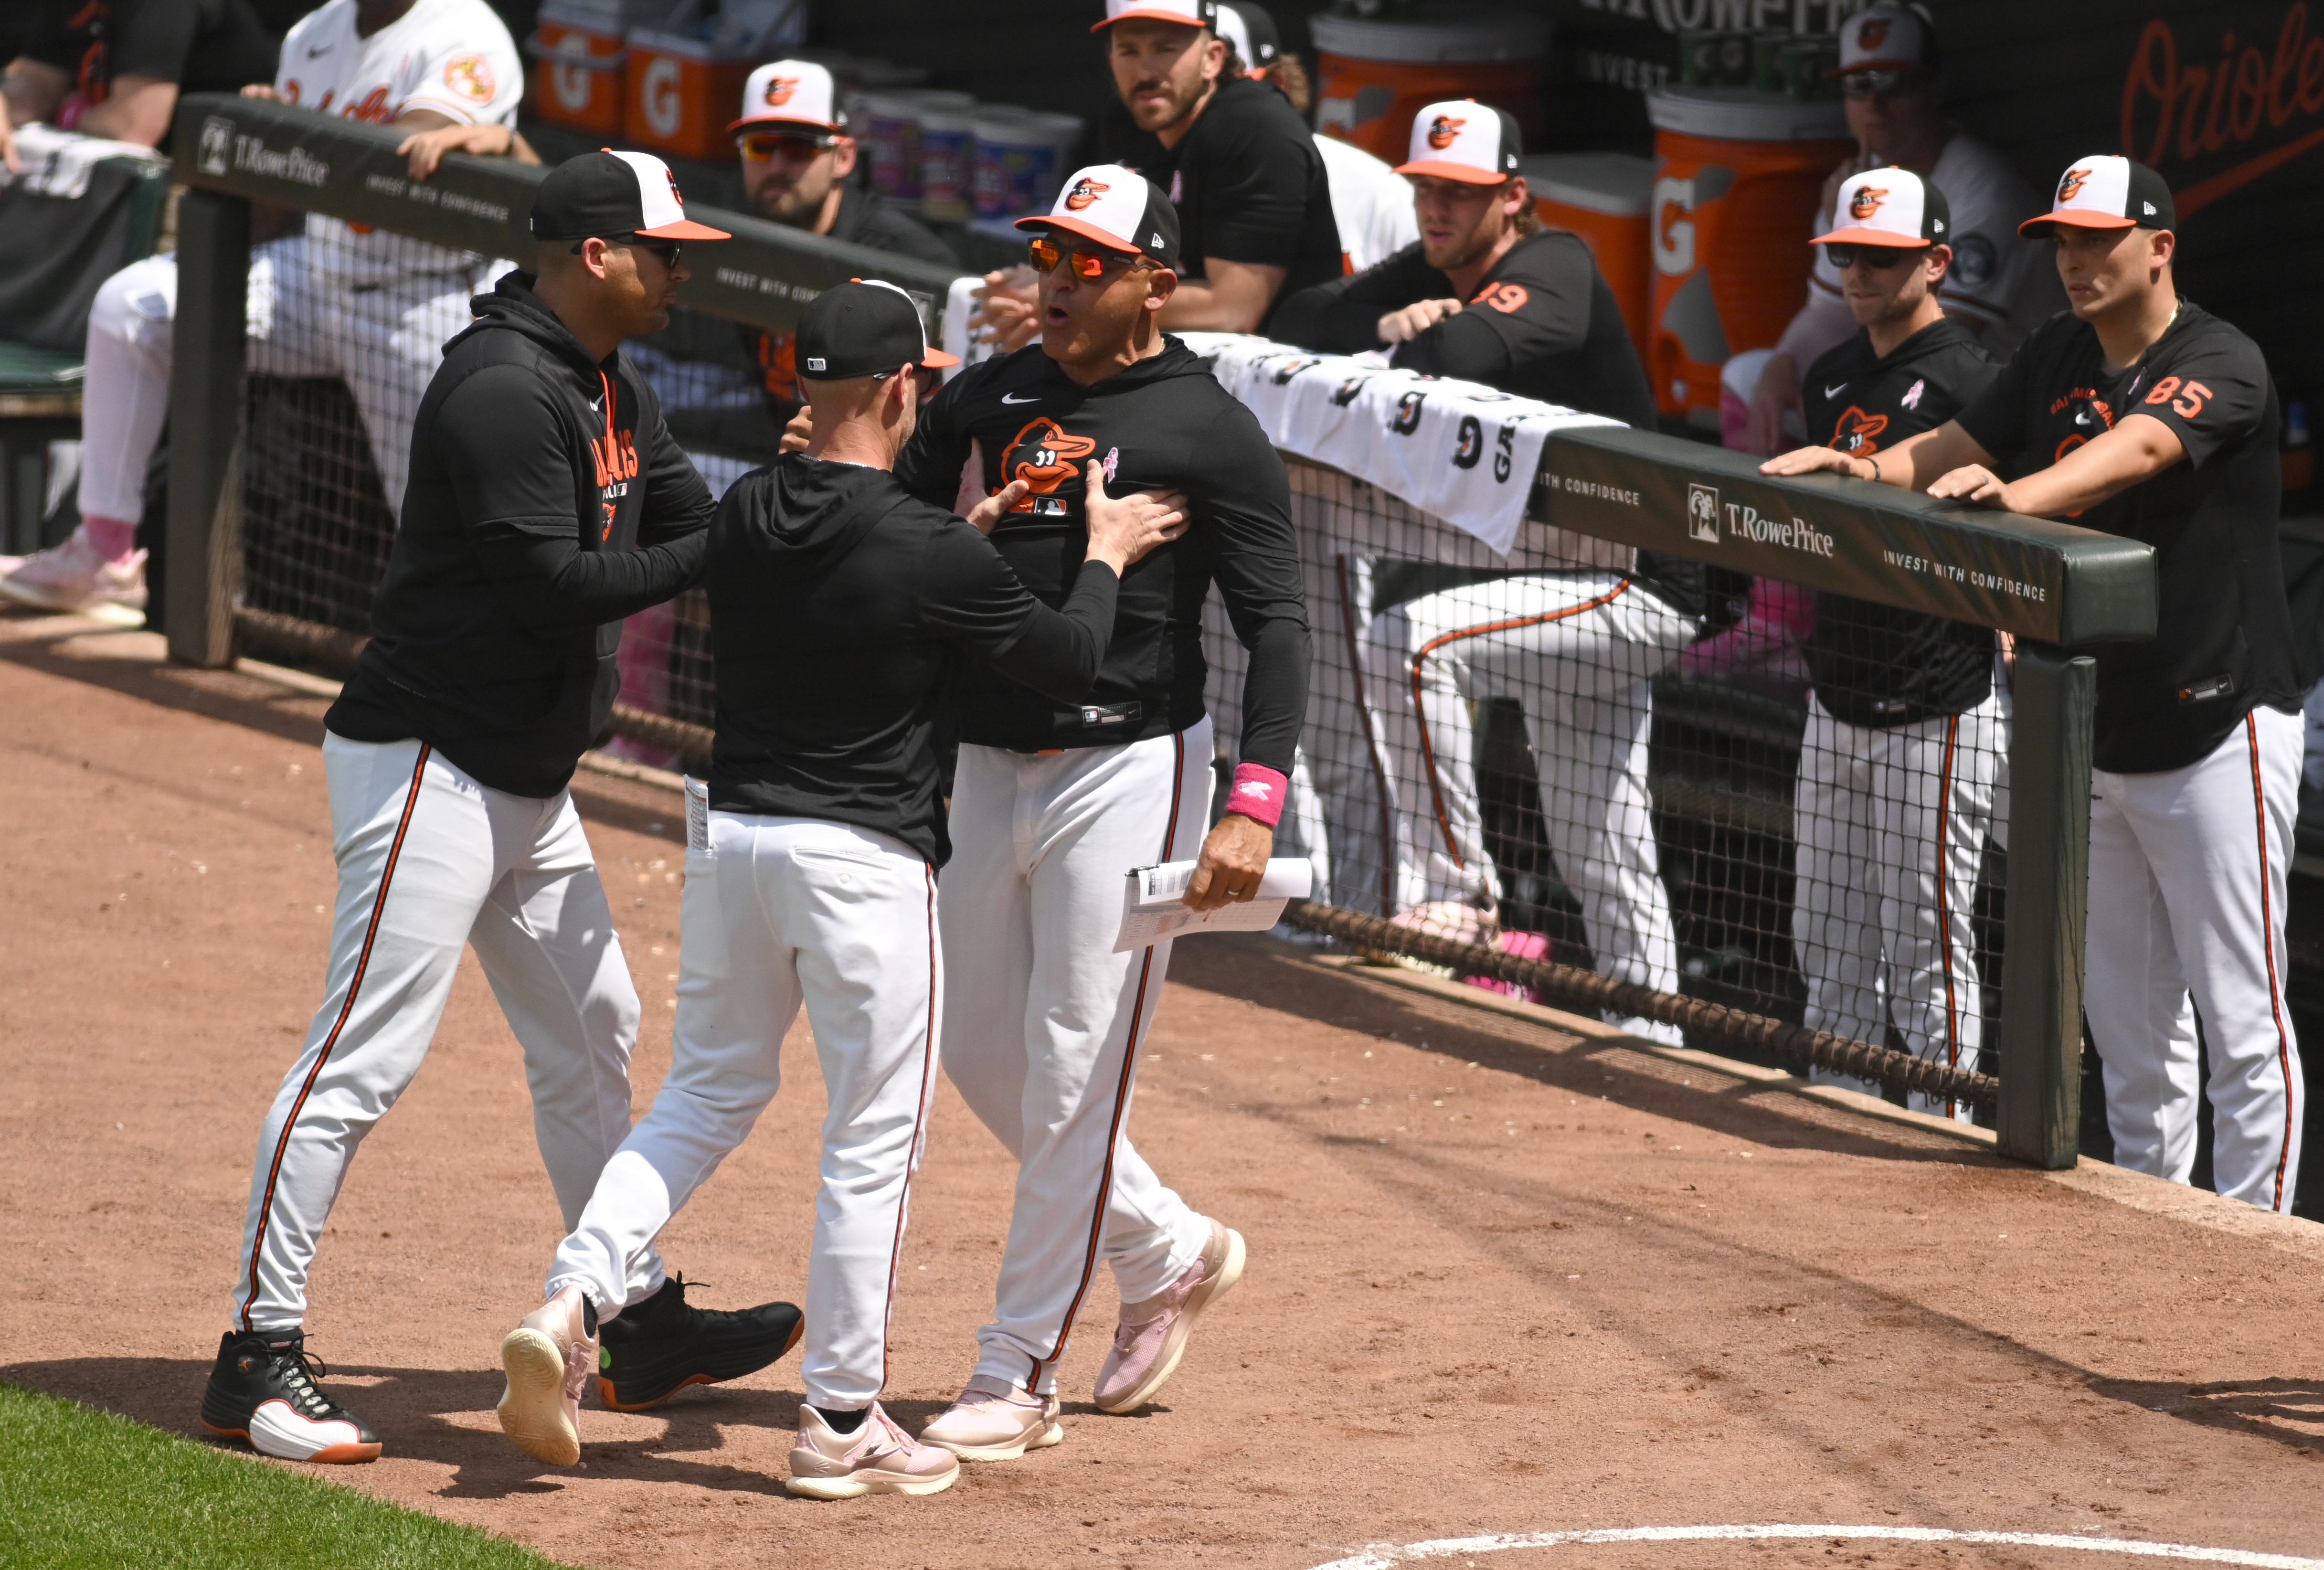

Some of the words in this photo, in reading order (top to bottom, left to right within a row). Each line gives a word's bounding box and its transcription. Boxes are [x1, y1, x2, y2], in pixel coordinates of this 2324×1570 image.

[642, 57, 681, 138] G
[1652, 178, 1695, 276] G
[717, 266, 757, 290] INVEST
[760, 277, 789, 297] WITH
[2144, 376, 2213, 418] 85
[1539, 472, 1560, 488] ITH
[1565, 477, 1640, 506] CONFIDENCE
[1725, 503, 1834, 558] T.RowePrice
[1884, 549, 1929, 573] INVEST
[1934, 562, 1965, 583] WITH
[1971, 571, 2045, 602] CONFIDENCE
